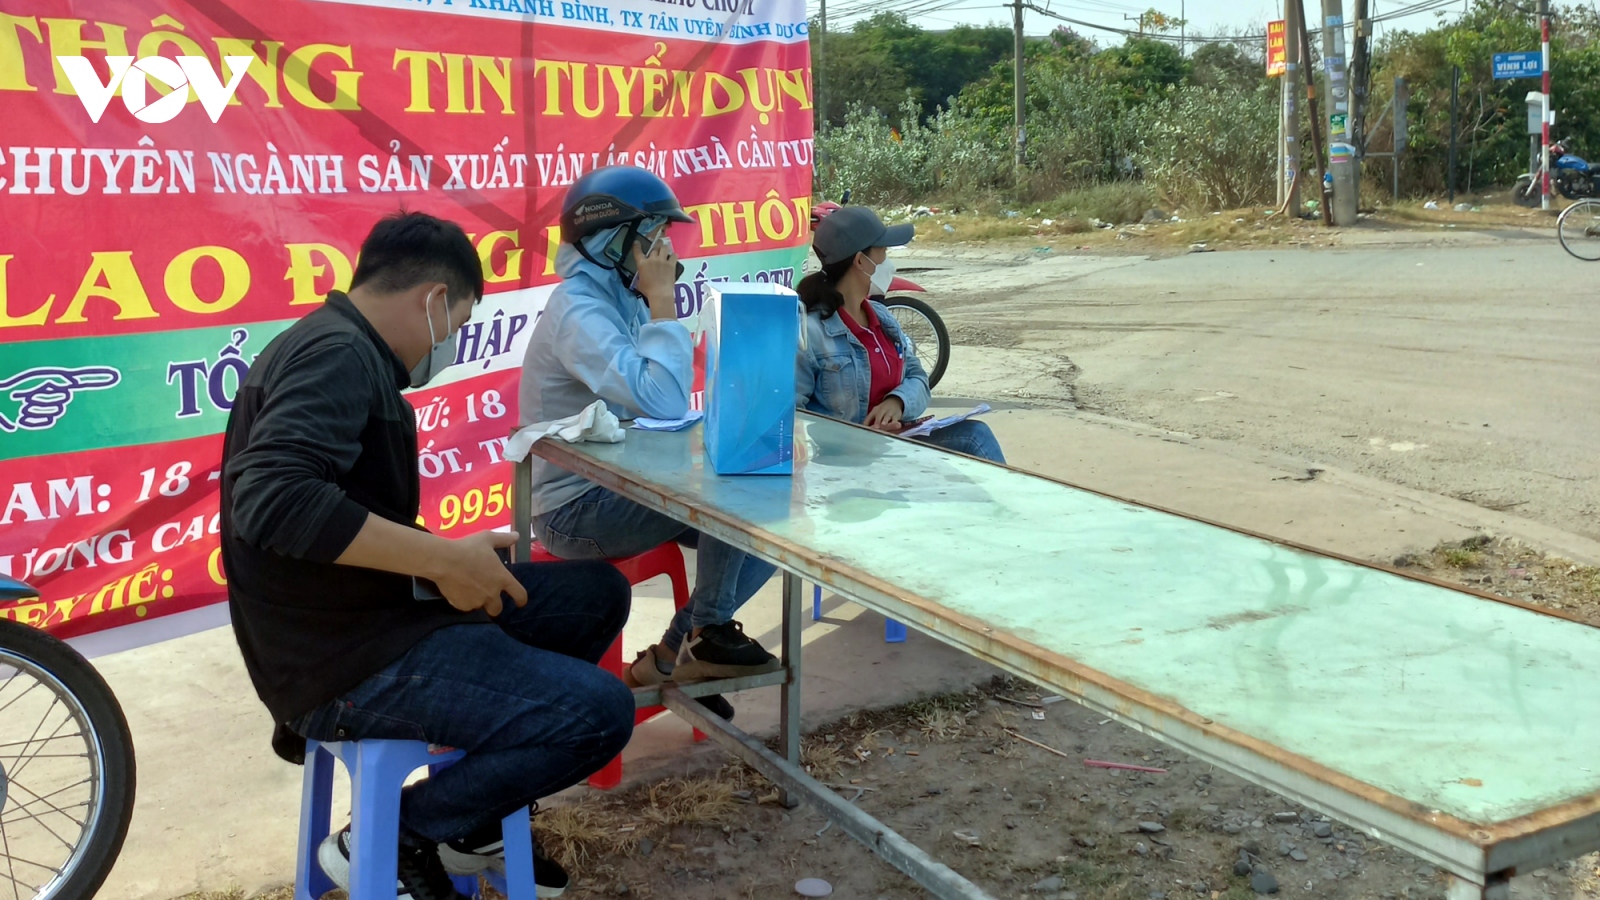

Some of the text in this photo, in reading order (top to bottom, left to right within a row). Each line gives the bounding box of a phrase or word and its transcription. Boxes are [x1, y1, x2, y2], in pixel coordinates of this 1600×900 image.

[620, 10, 643, 28] TX
[648, 11, 679, 32] TÂN
[683, 17, 724, 37] UYÊN
[729, 22, 771, 38] BÌNH
[393, 48, 516, 115] TIN
[532, 41, 695, 118] TUYỂN
[700, 67, 813, 126] DỤN
[0, 134, 196, 195] HUYÊN
[206, 141, 348, 195] NGÀNH
[358, 139, 433, 193] SẢN
[442, 136, 528, 190] XUẤT
[535, 142, 586, 187] VÁN
[672, 135, 733, 178] NHÀ
[736, 124, 777, 168] CẦN
[0, 245, 252, 328] LAO
[283, 228, 525, 306] ĐG
[135, 461, 193, 504] 18
[465, 389, 507, 423] 18
[439, 482, 512, 530] 995
